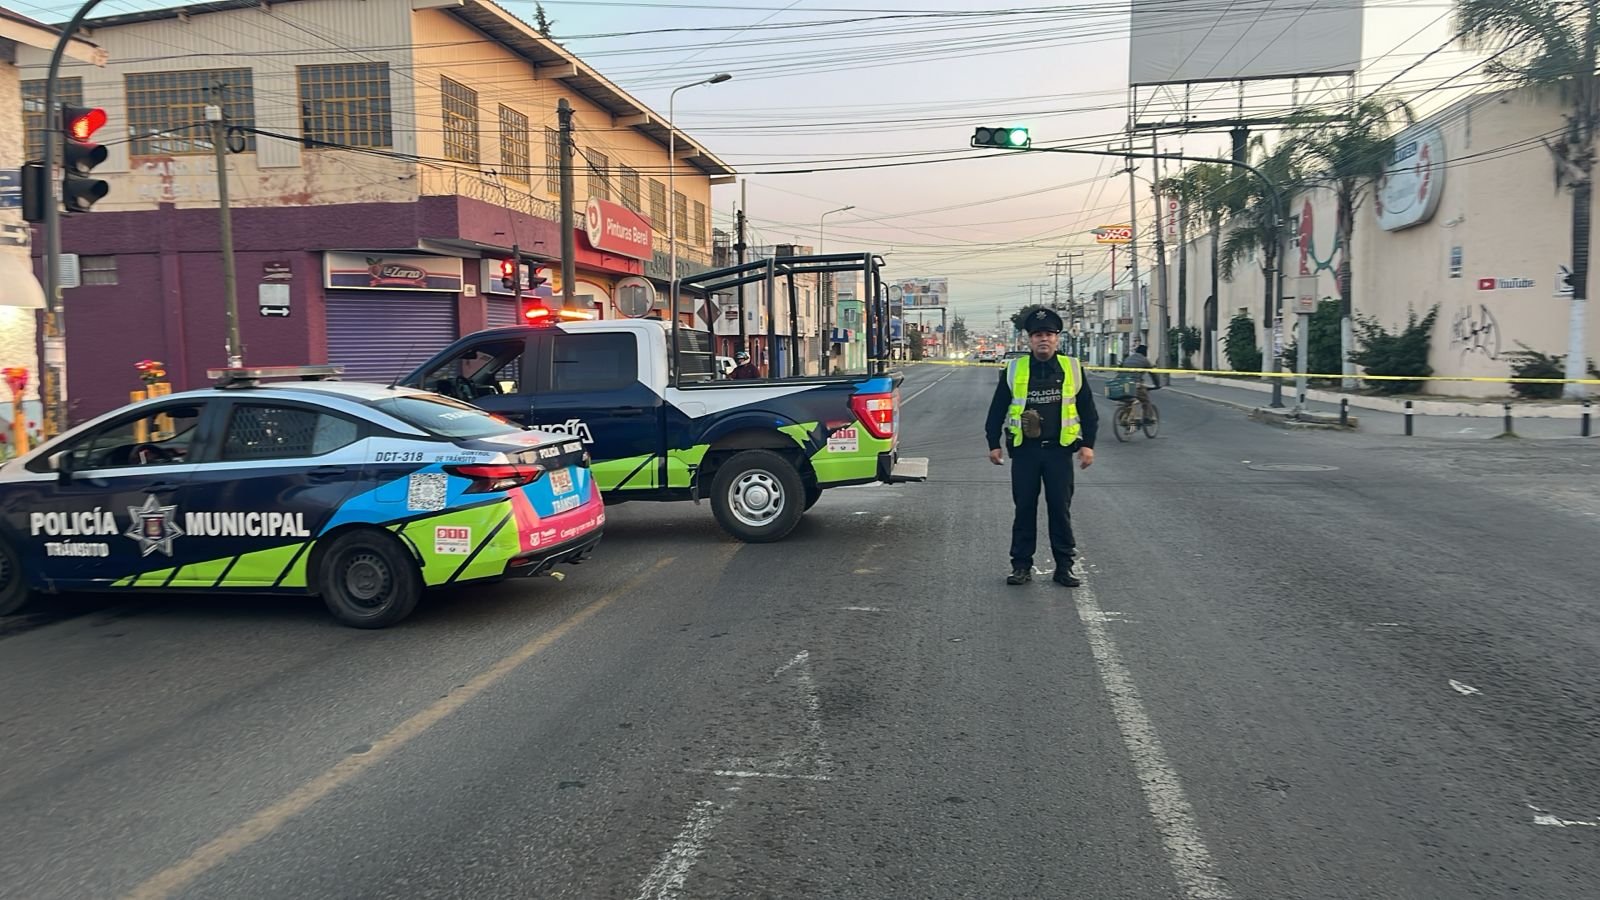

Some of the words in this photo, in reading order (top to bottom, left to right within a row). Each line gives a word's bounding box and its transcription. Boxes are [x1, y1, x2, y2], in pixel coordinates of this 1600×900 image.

[606, 217, 633, 241] Pinturas
[632, 226, 649, 246] Berel
[375, 451, 424, 462] DCT-318
[30, 506, 119, 536] POLICÍA
[185, 511, 311, 537] MUNICIPAL
[437, 529, 468, 539] 911
[44, 539, 110, 557] TRÁNSITO
